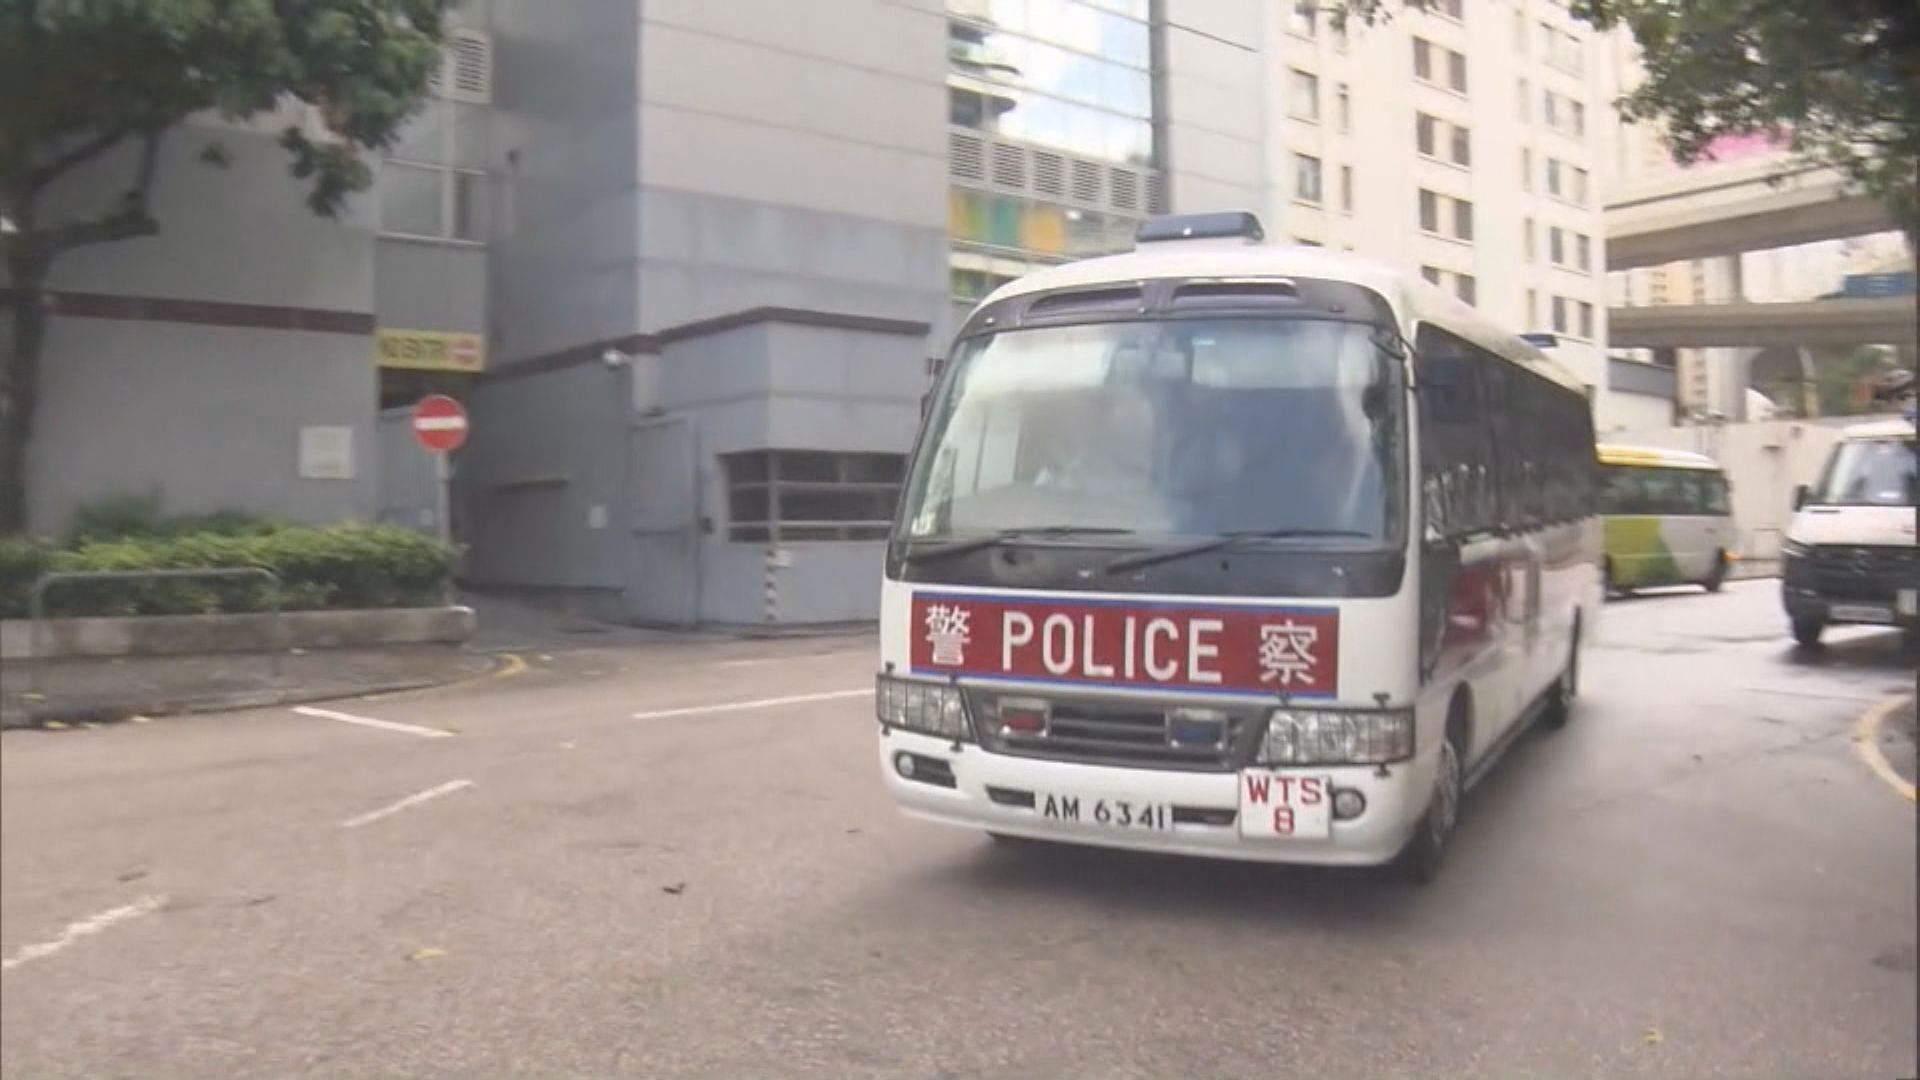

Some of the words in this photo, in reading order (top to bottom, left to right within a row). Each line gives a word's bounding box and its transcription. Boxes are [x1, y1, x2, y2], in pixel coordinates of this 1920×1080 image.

[925, 604, 971, 665] 警
[1002, 611, 1223, 684] POLICE
[1259, 618, 1317, 685] 察
[1246, 775, 1322, 805] WTS
[1044, 792, 1080, 821] AM
[1094, 798, 1164, 829] 6341
[1274, 806, 1295, 833] 8
